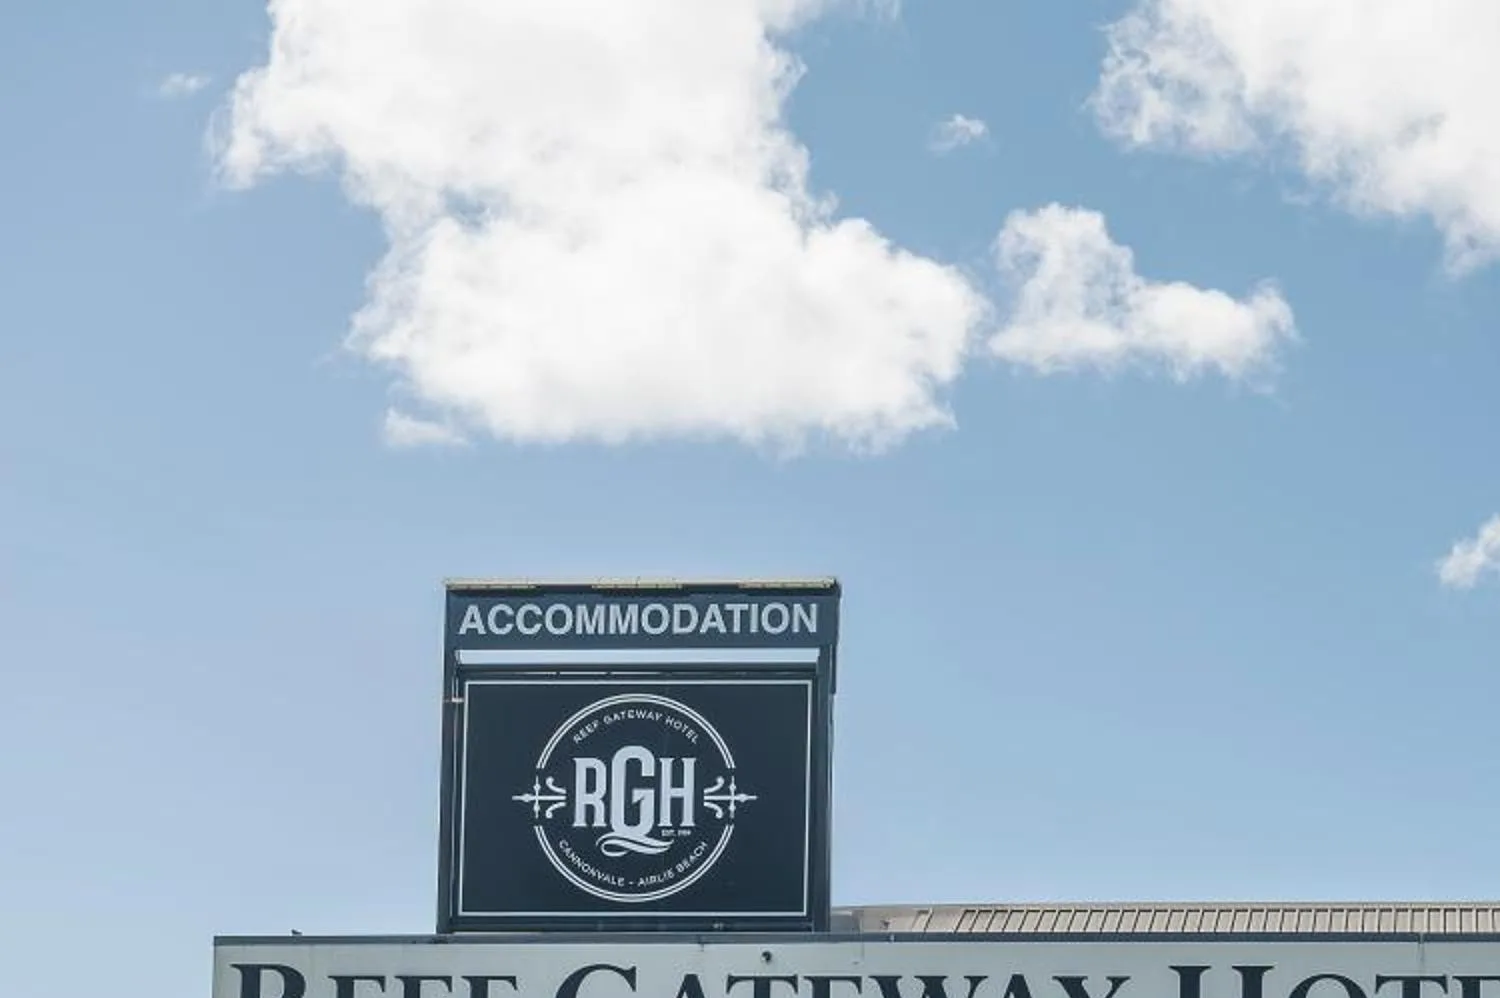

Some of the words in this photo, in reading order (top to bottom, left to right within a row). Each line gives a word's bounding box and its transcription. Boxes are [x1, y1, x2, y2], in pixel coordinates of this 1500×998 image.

[458, 602, 819, 636] ACCOMMODATION
[573, 719, 599, 744] REEF
[603, 708, 662, 725] GATEWAY
[664, 715, 699, 745] HOTEL
[572, 744, 697, 857] RGH
[559, 839, 625, 887] CANNONVALE
[637, 867, 675, 887] AIRLIE
[675, 841, 708, 873] BEACH
